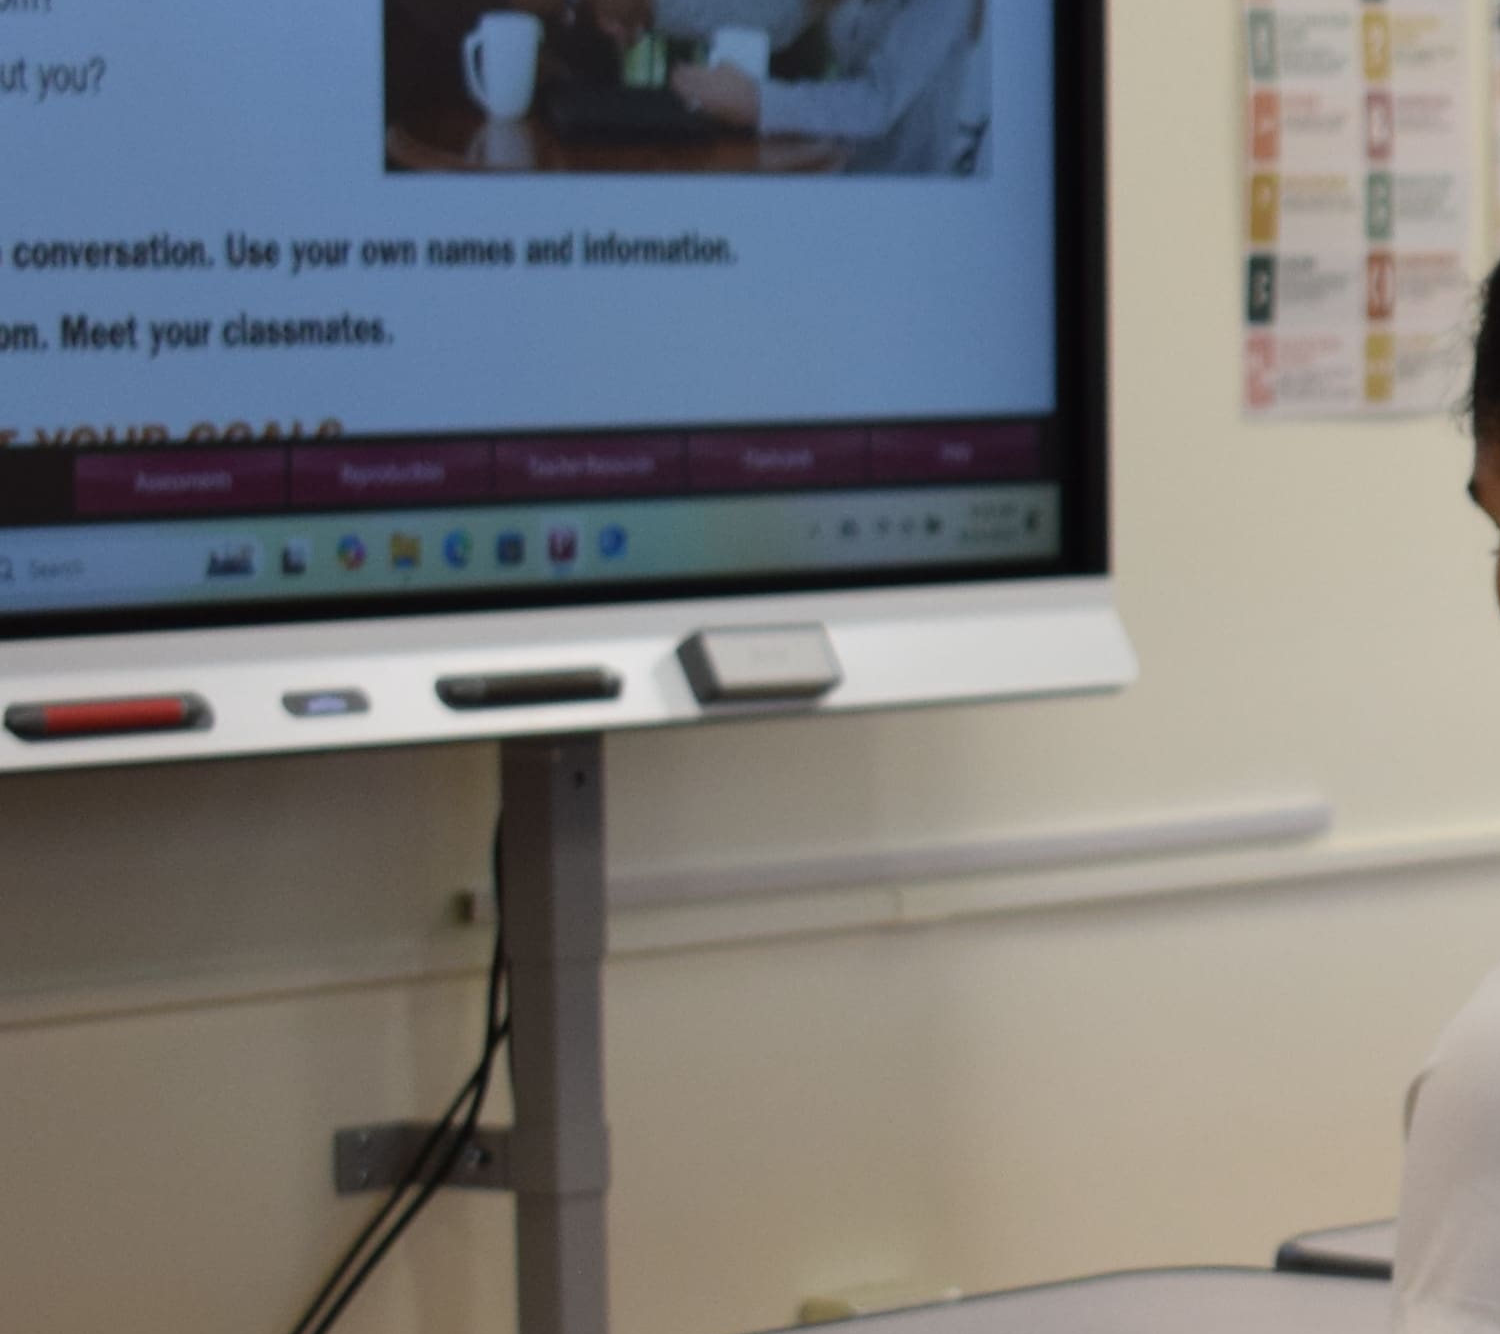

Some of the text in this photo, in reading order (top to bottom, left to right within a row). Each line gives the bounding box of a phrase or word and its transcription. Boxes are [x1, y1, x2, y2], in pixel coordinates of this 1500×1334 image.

[37, 56, 105, 98] you?
[12, 228, 738, 275] conversation. Use your own names and information.
[60, 313, 138, 349] Meet
[149, 317, 210, 359] your
[222, 311, 394, 347] classmates.
